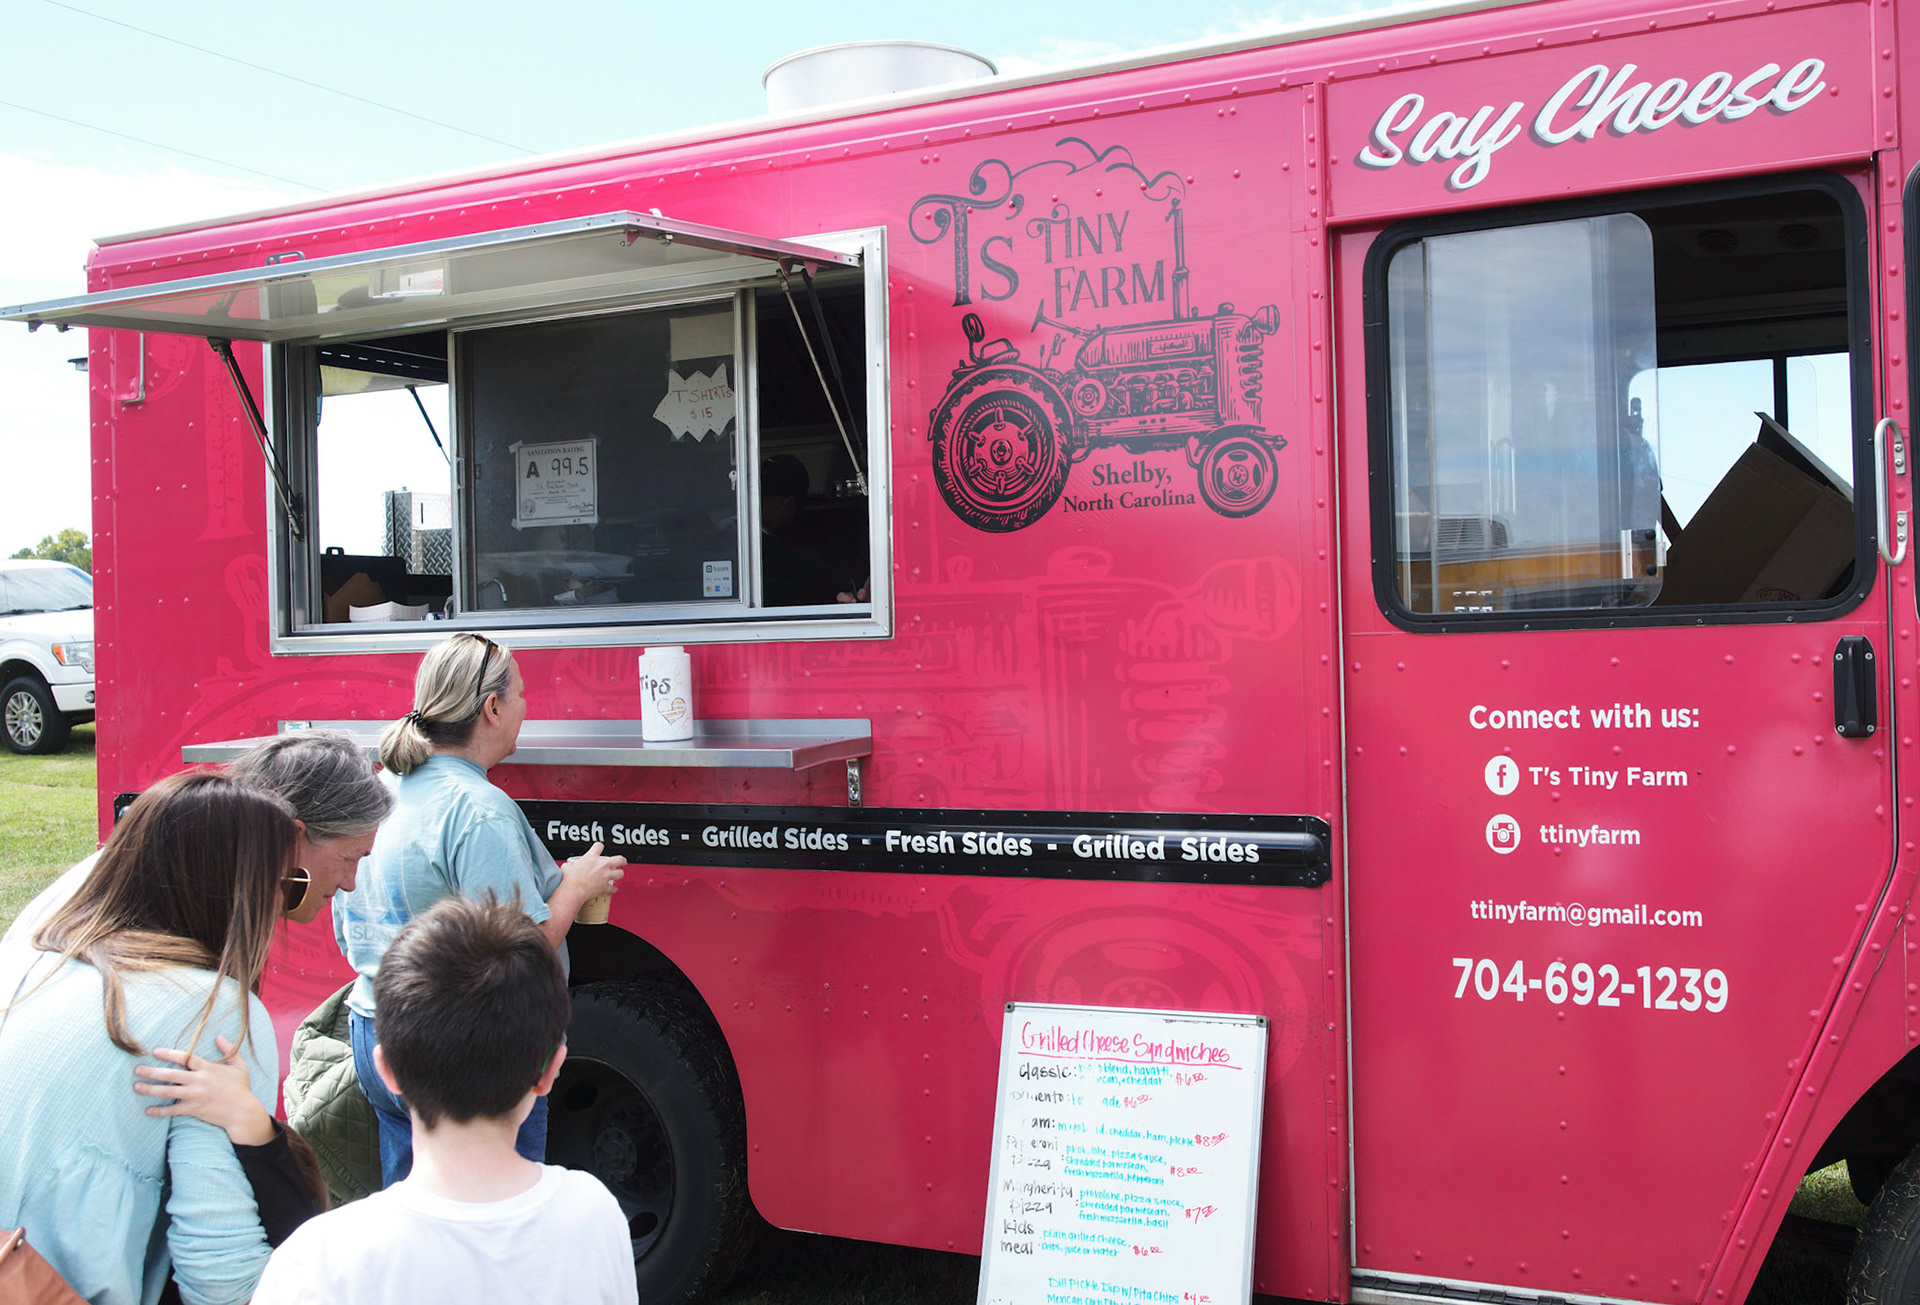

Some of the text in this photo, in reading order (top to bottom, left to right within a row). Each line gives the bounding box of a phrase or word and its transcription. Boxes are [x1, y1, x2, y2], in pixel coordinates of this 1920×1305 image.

[1356, 58, 1826, 191] Say Cheese
[526, 446, 585, 456] SANITATION RATING
[526, 456, 589, 478] A 99.5
[1092, 461, 1172, 488] Shelby,
[1063, 489, 1196, 513] North Carolina
[1469, 703, 1700, 729] Connect with us:
[1528, 767, 1688, 789] T's Tiny Farm
[547, 820, 604, 842] Fresh
[612, 823, 670, 846] Sides
[702, 825, 779, 849] Grilled
[784, 827, 849, 851] Sides
[885, 830, 955, 855] Fresh
[963, 831, 1032, 857] Sides
[1073, 834, 1165, 860] Grilled
[1181, 837, 1260, 863] Sides
[1540, 825, 1641, 847] ttinyfarm
[1470, 900, 1703, 927] ttinyfarm@gmail.com
[1452, 957, 1729, 1013] 704-692-1239
[1022, 1021, 1230, 1063] Grilled Cheese Sandwiches
